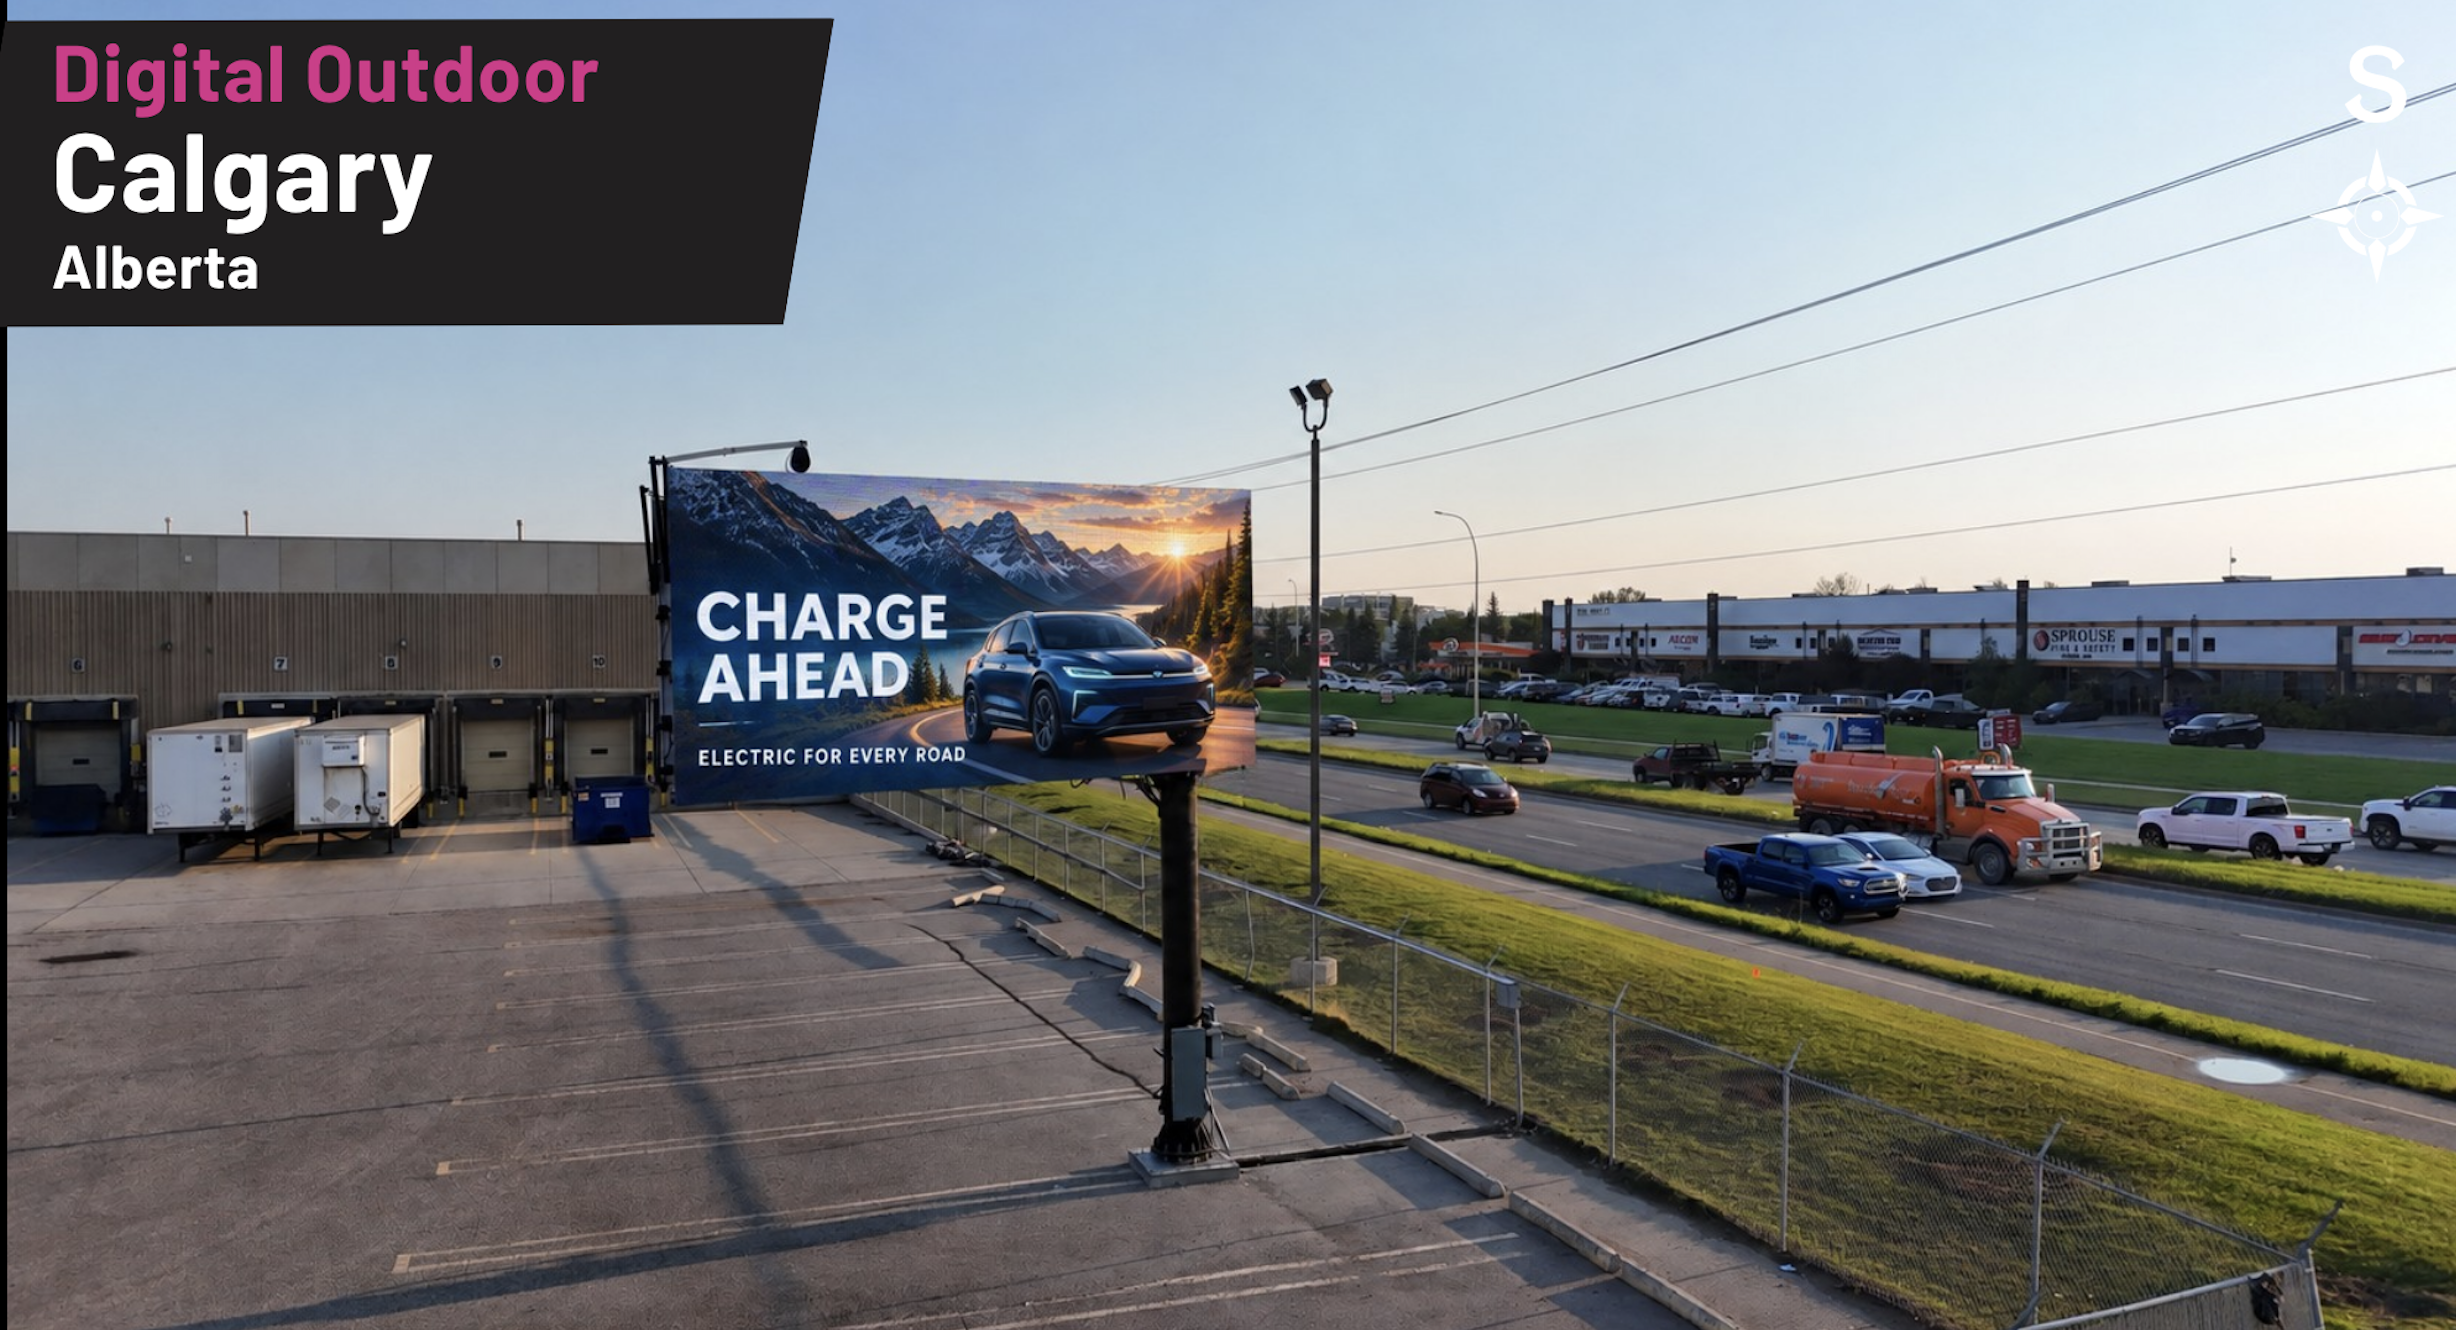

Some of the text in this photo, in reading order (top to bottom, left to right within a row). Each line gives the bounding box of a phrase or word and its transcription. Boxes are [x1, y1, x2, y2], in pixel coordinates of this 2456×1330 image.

[697, 591, 947, 642] CHARGE
[2051, 629, 2116, 643] SPROUSE
[73, 660, 83, 671] 6
[276, 659, 285, 668] 7
[493, 657, 501, 667] 9
[594, 657, 605, 667] 10
[698, 651, 909, 703] AHEAD
[699, 746, 966, 766] ELECTRIC FOR EVERY ROAD
